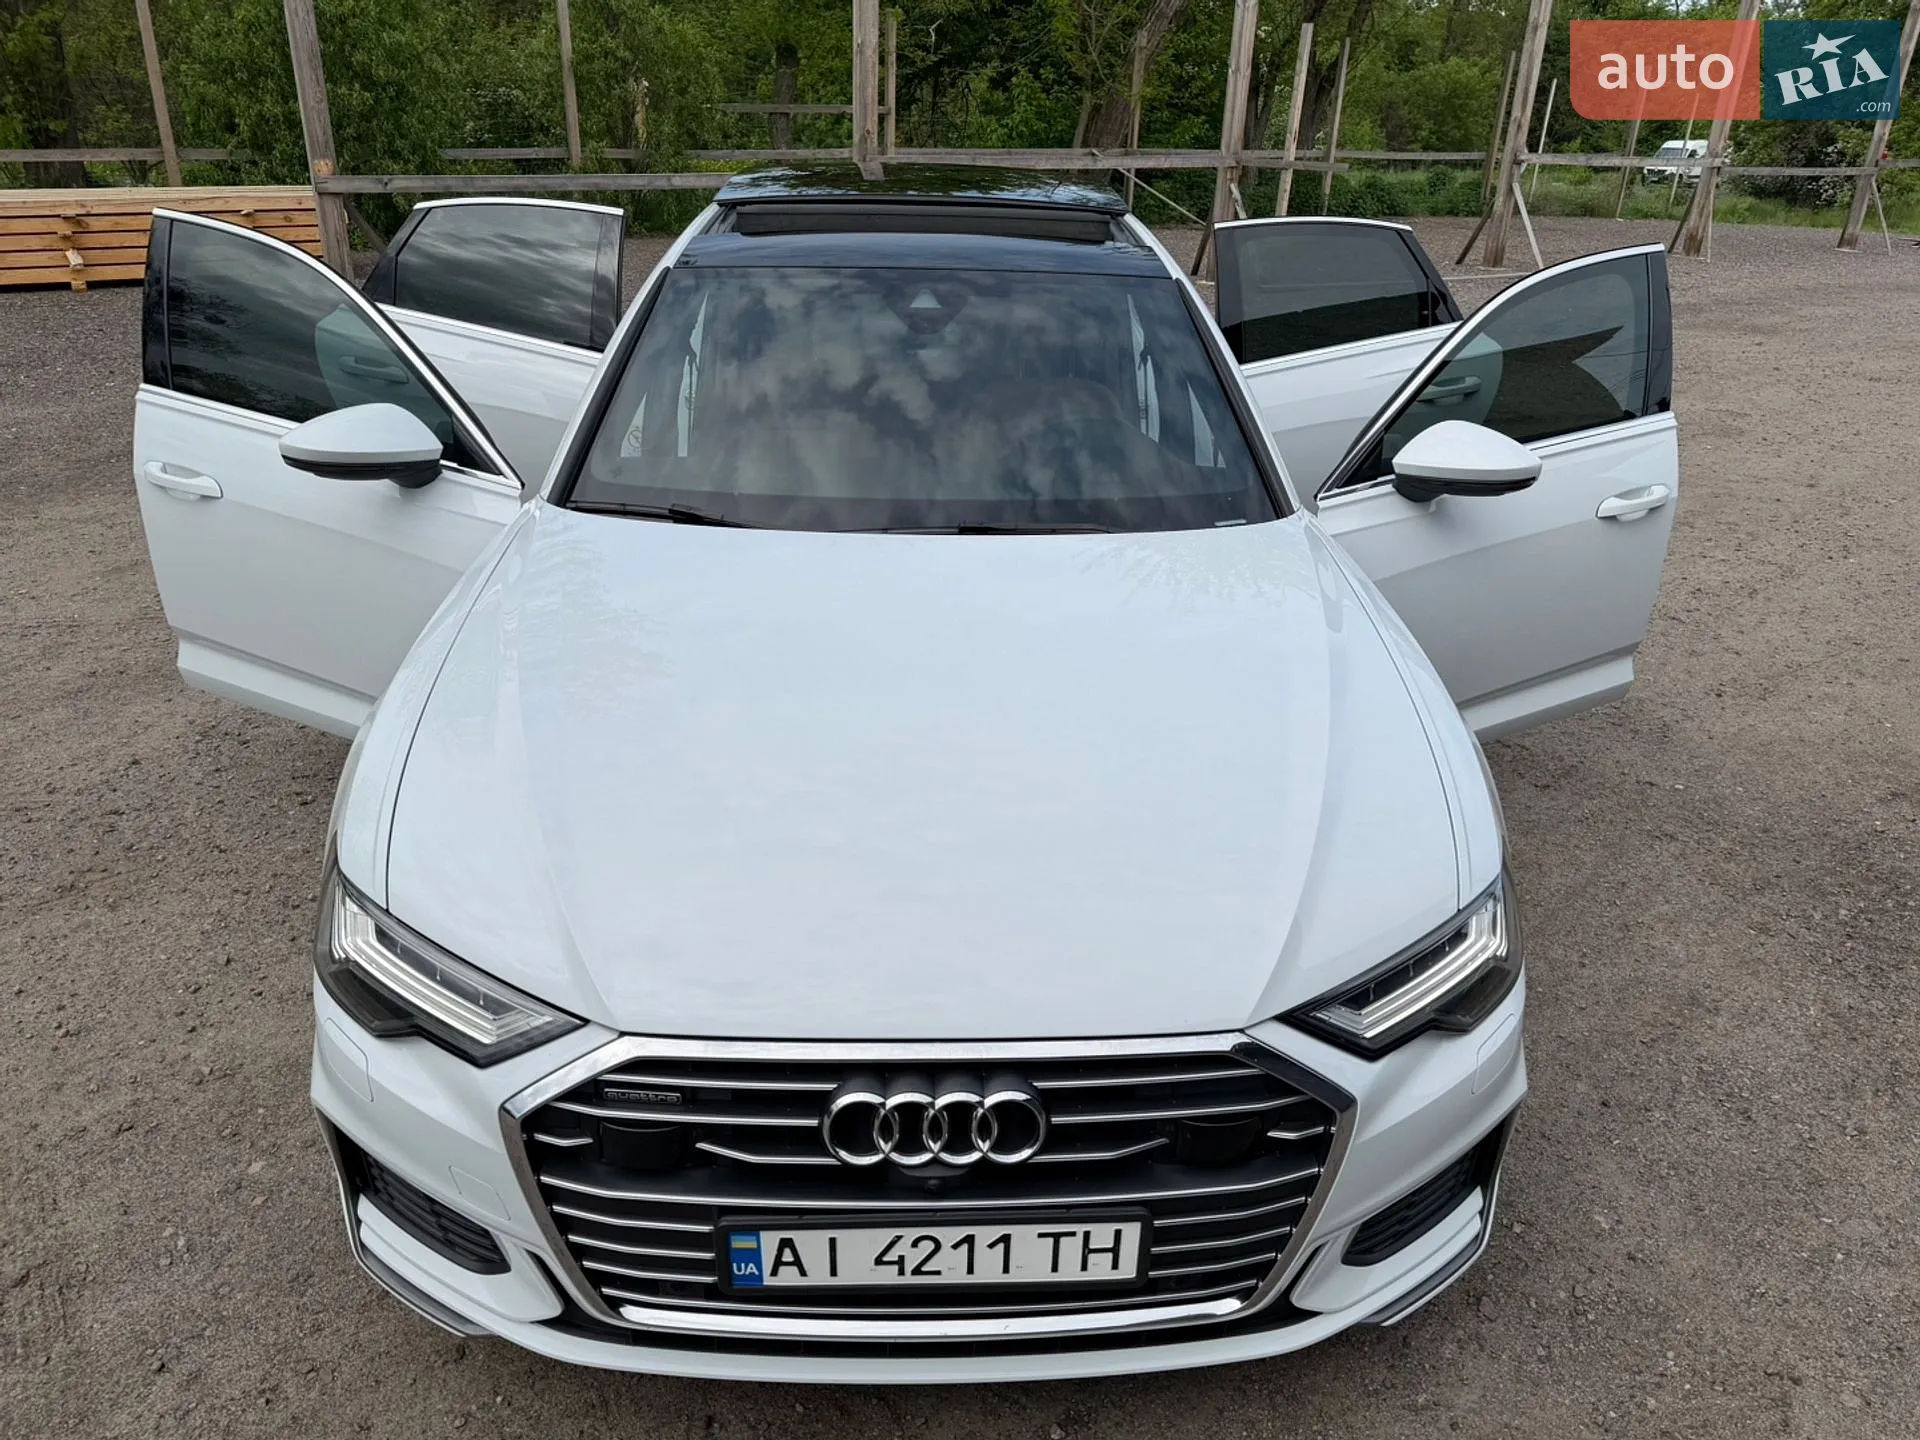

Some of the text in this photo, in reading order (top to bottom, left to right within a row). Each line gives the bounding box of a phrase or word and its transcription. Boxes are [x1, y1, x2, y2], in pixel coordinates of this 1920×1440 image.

[606, 1091, 678, 1104] quattro
[769, 1228, 1122, 1277] AI 4211 TH
[732, 1262, 759, 1276] UA
